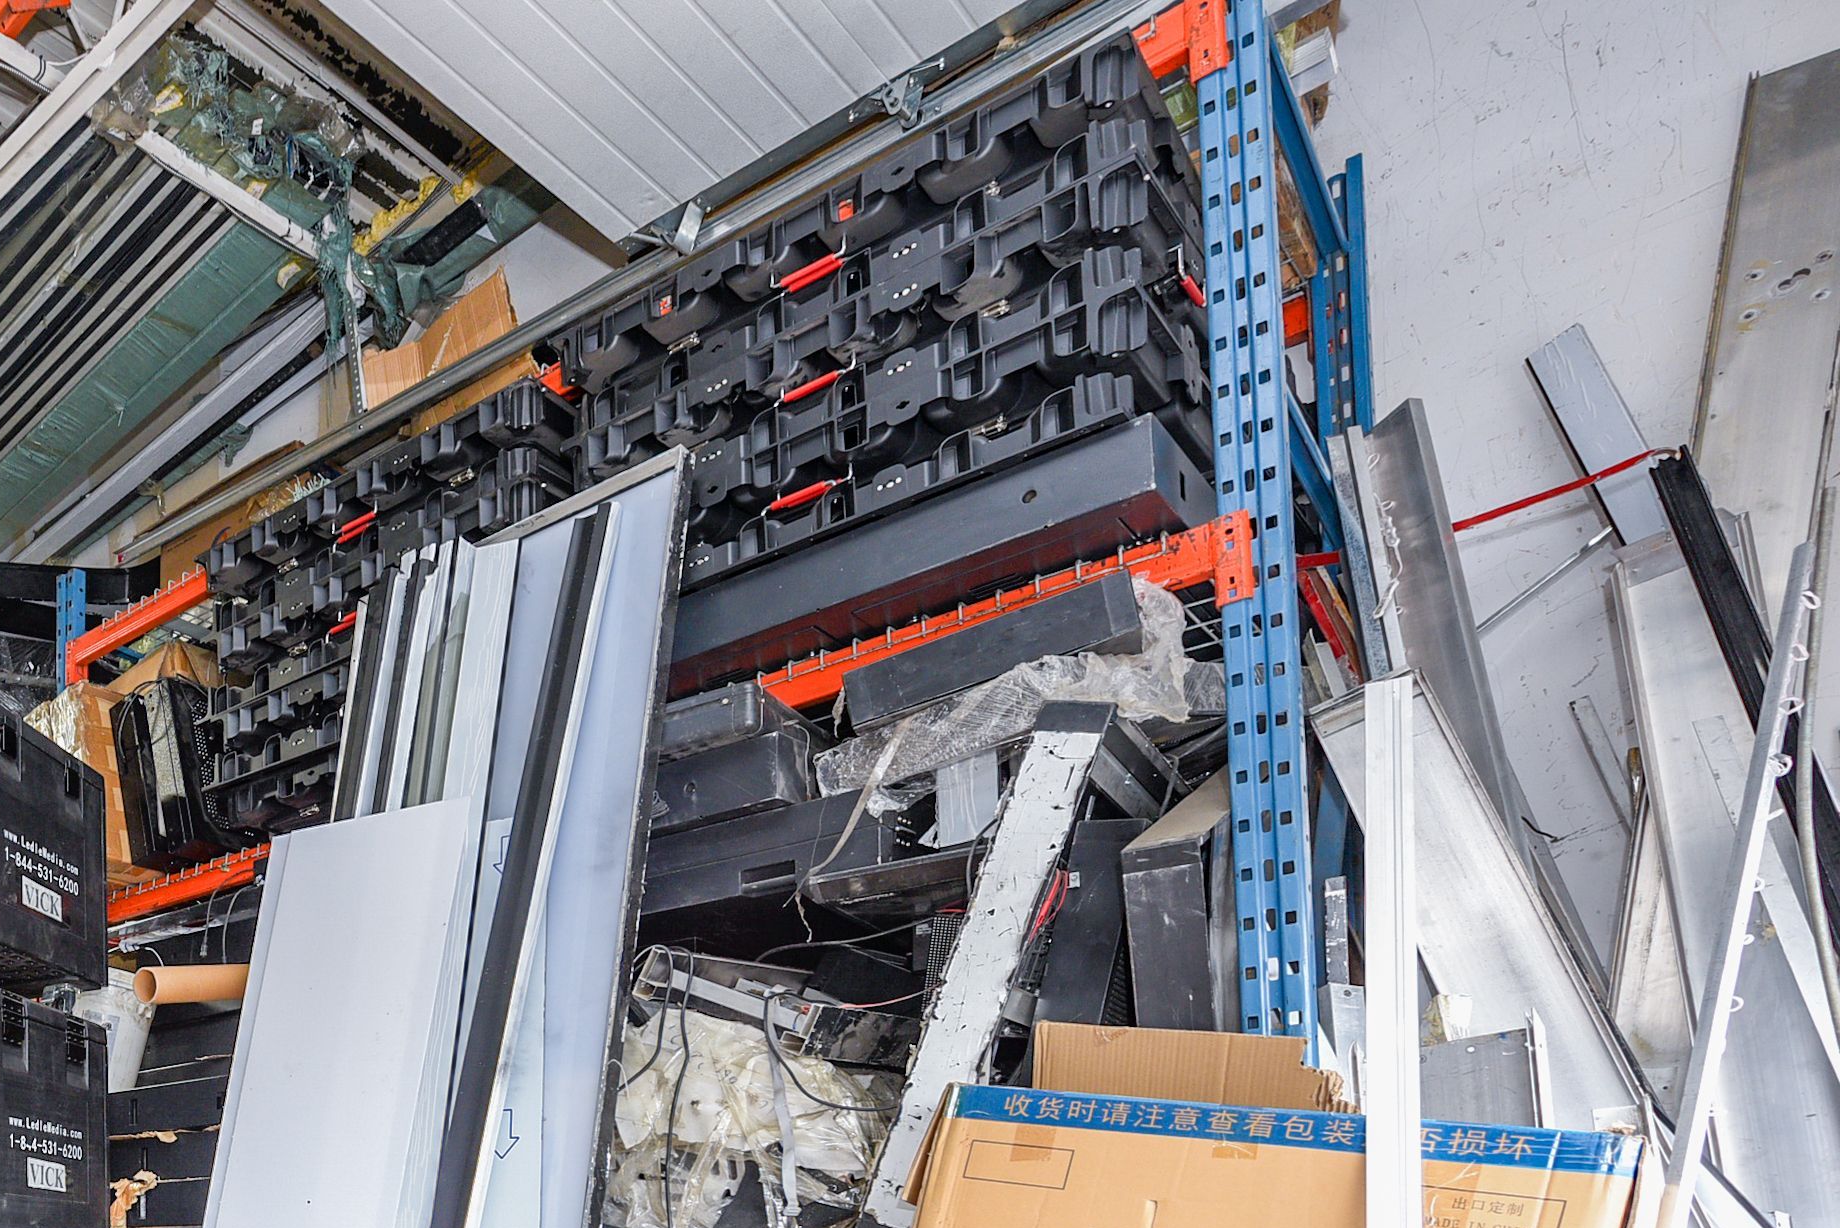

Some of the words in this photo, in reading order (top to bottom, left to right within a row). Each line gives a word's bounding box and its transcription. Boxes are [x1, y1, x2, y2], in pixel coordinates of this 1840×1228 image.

[4, 846, 79, 896] 1-844-531-6200
[24, 883, 60, 918] VICK
[1003, 1092, 1536, 1162] 收货时请注意查看包装否损坏
[29, 1163, 64, 1189] VICK
